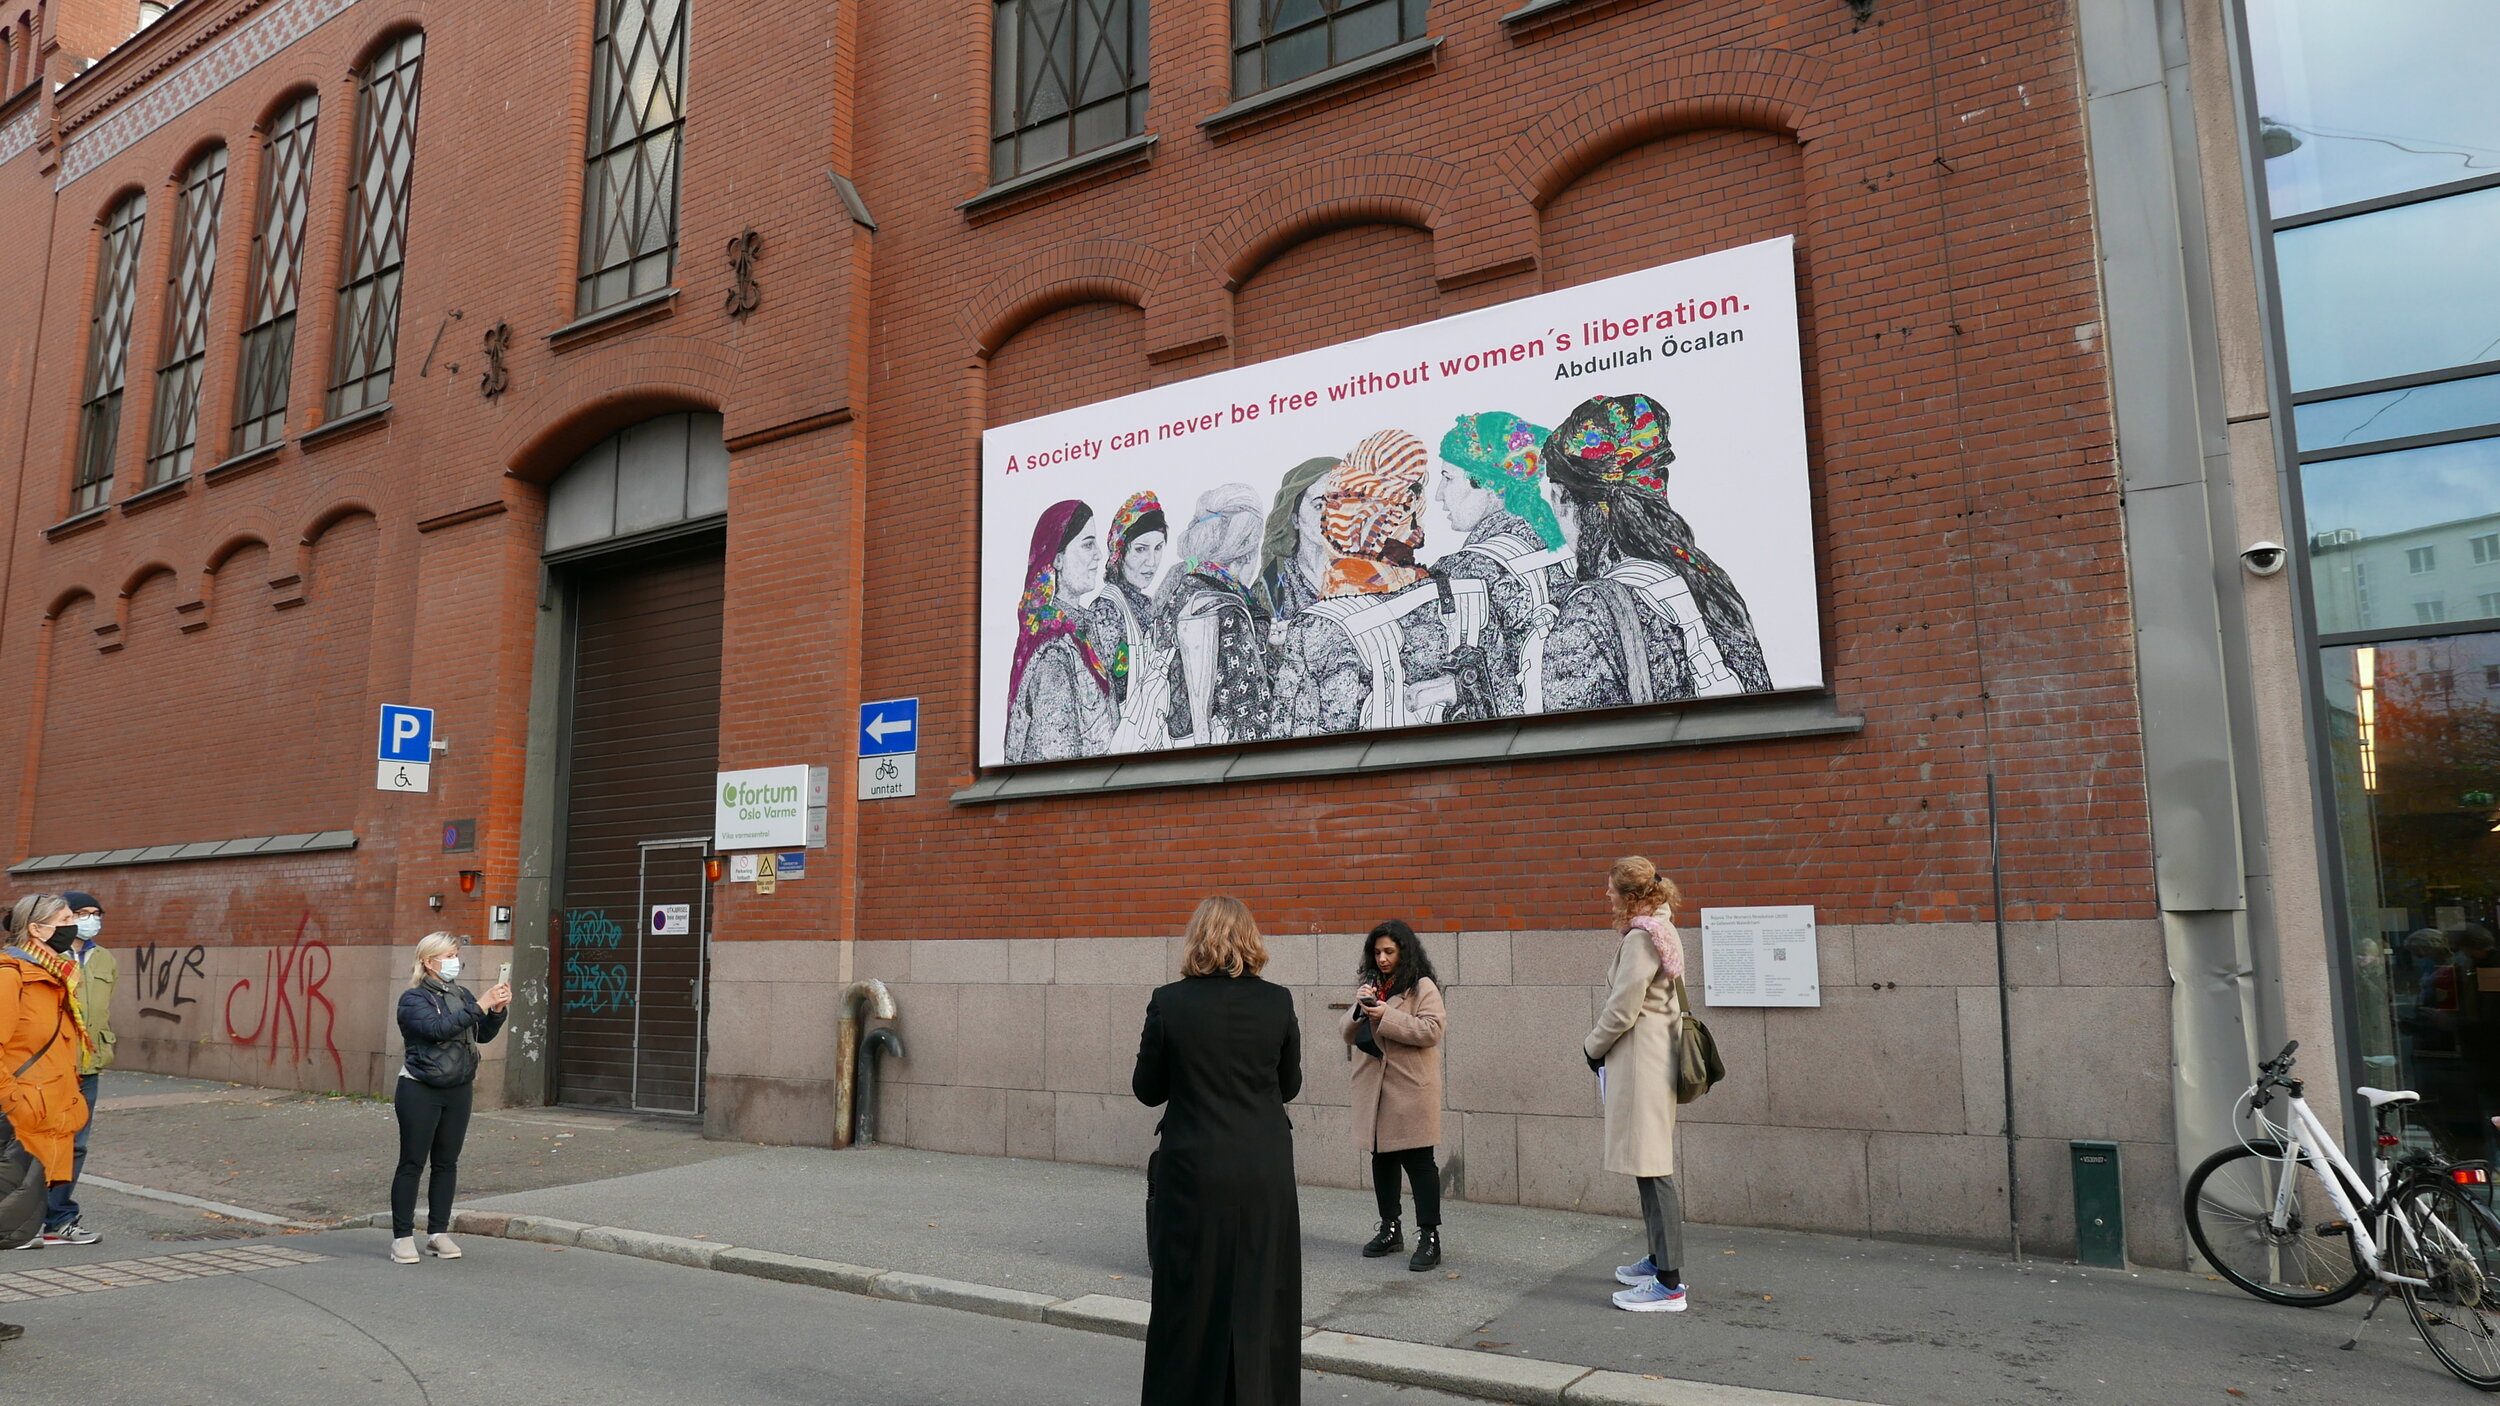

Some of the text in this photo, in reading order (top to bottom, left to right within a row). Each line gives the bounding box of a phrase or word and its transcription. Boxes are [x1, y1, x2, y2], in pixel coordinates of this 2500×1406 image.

[1554, 328, 1744, 381] Abdullah Öcalan
[1005, 454, 1020, 475] A
[1026, 436, 1103, 470] society
[1110, 425, 1150, 451] can
[1158, 409, 1223, 440] never
[1231, 402, 1260, 425] be
[1268, 390, 1319, 415] free
[1327, 359, 1431, 402] without
[1583, 292, 1751, 346] liberation.
[392, 713, 420, 753] P
[739, 781, 798, 806] fortum
[871, 783, 903, 795] unntatt
[739, 807, 761, 820] Oslo
[764, 806, 797, 819] Varme
